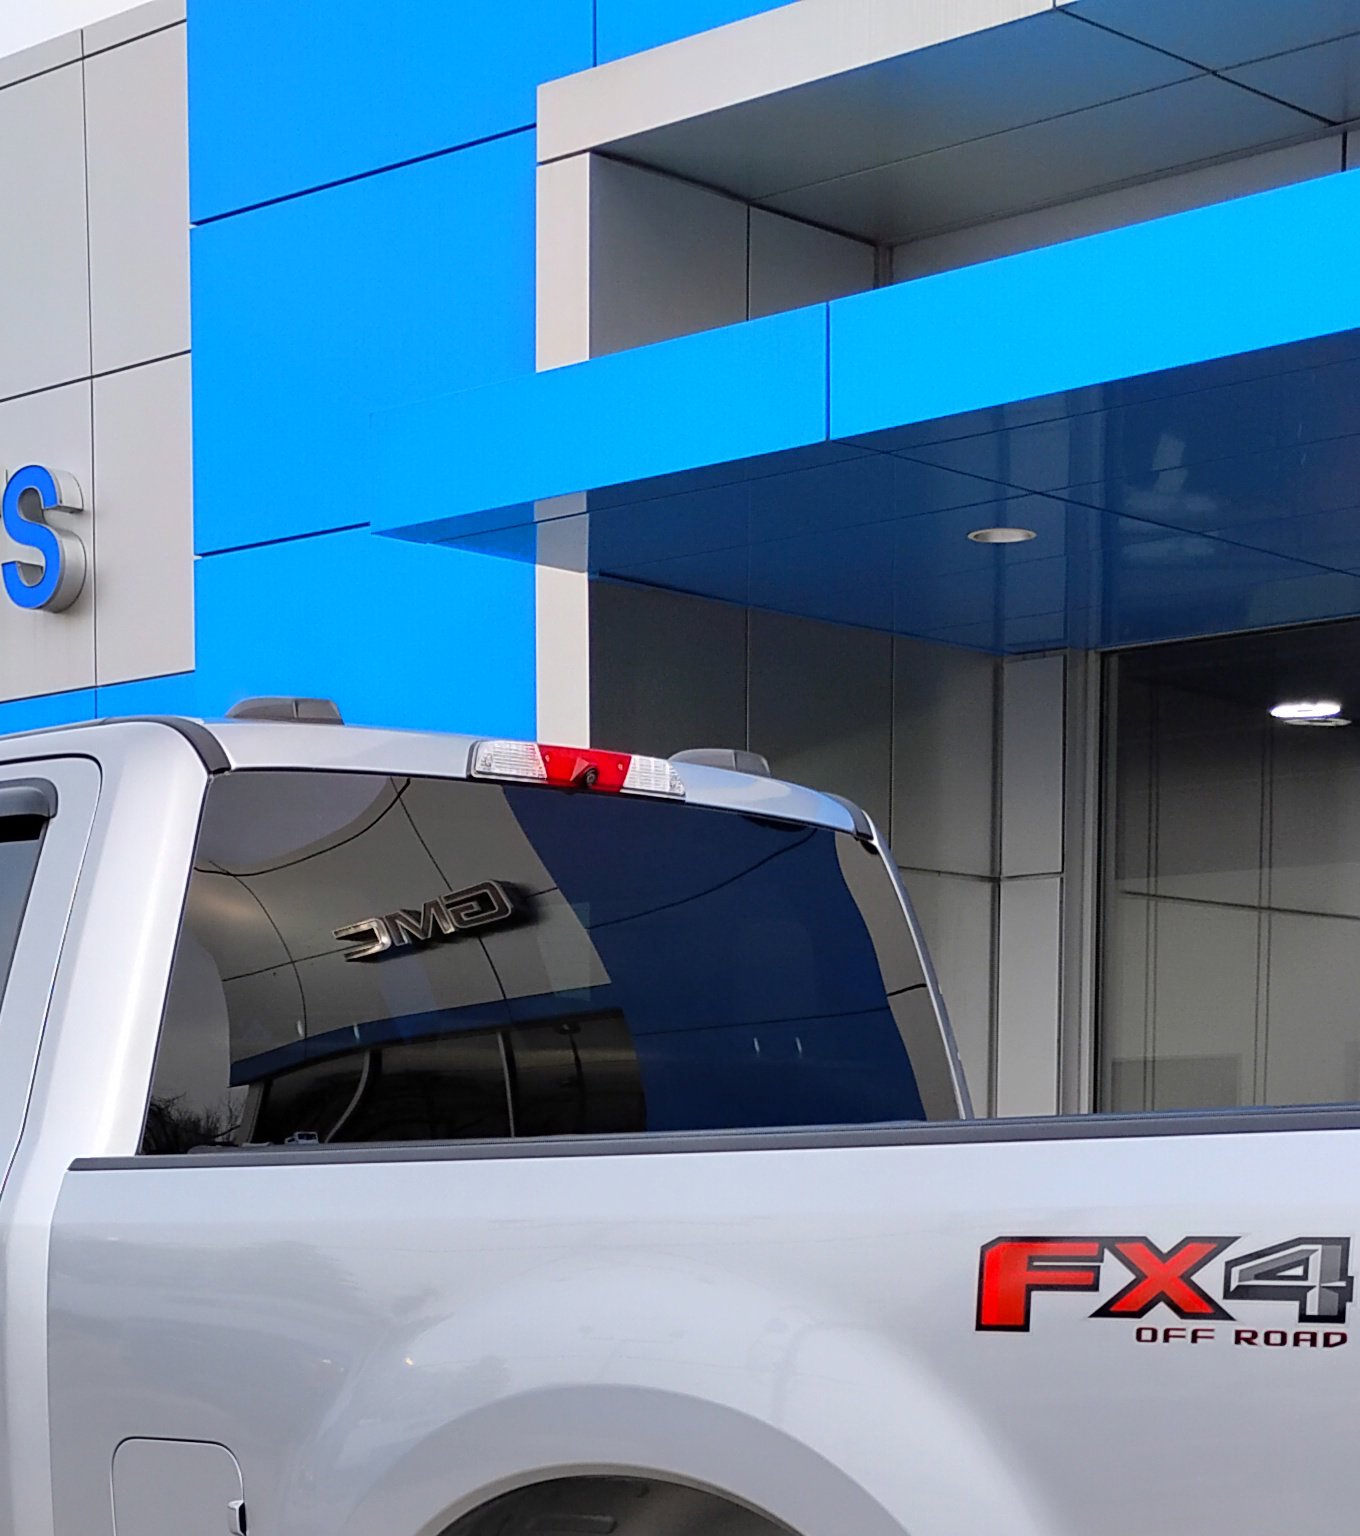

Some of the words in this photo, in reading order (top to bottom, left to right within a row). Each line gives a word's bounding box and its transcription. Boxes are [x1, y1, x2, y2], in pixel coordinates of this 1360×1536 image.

[975, 1235, 1354, 1332] FX4
[1135, 1326, 1215, 1344] OFF
[1234, 1328, 1348, 1348] ROAD
